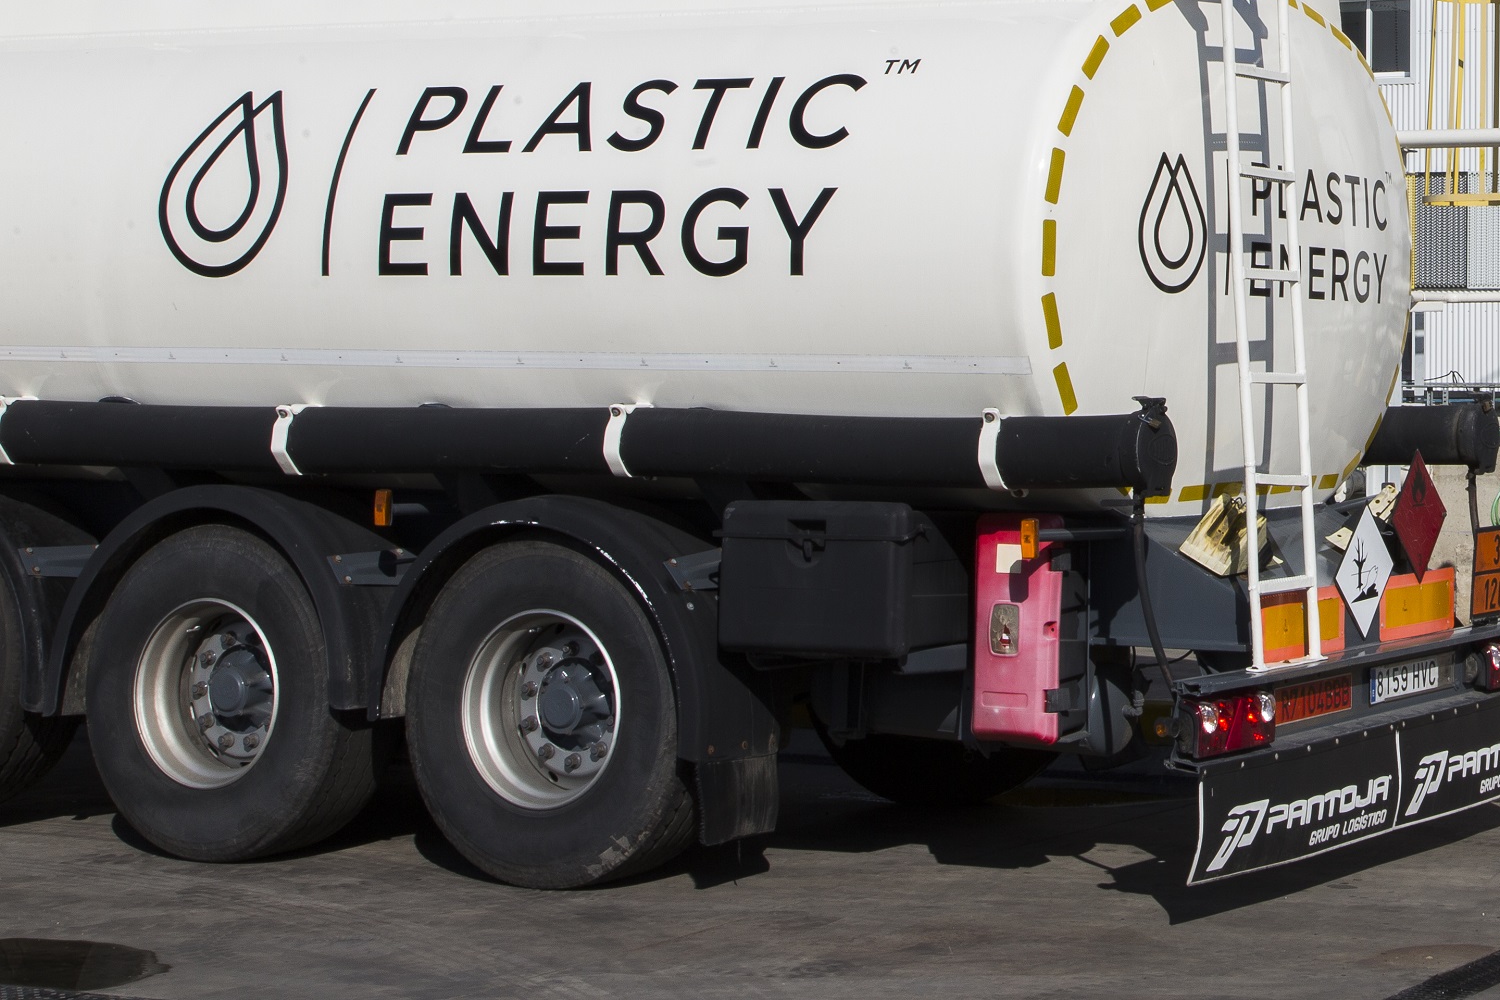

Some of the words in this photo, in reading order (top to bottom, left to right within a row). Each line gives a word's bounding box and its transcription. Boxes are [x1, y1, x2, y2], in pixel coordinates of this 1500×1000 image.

[395, 73, 868, 156] PLASTIC
[1251, 162, 1388, 231] PLASTIC
[378, 187, 839, 277] ENERGY
[1250, 242, 1388, 304] ENERGY
[1376, 665, 1408, 698] 8159
[1412, 660, 1437, 690] HVC
[1266, 775, 1391, 834] PANTOJA
[1309, 824, 1340, 846] GRUPO
[1342, 809, 1387, 836] LOGÍSTICO
